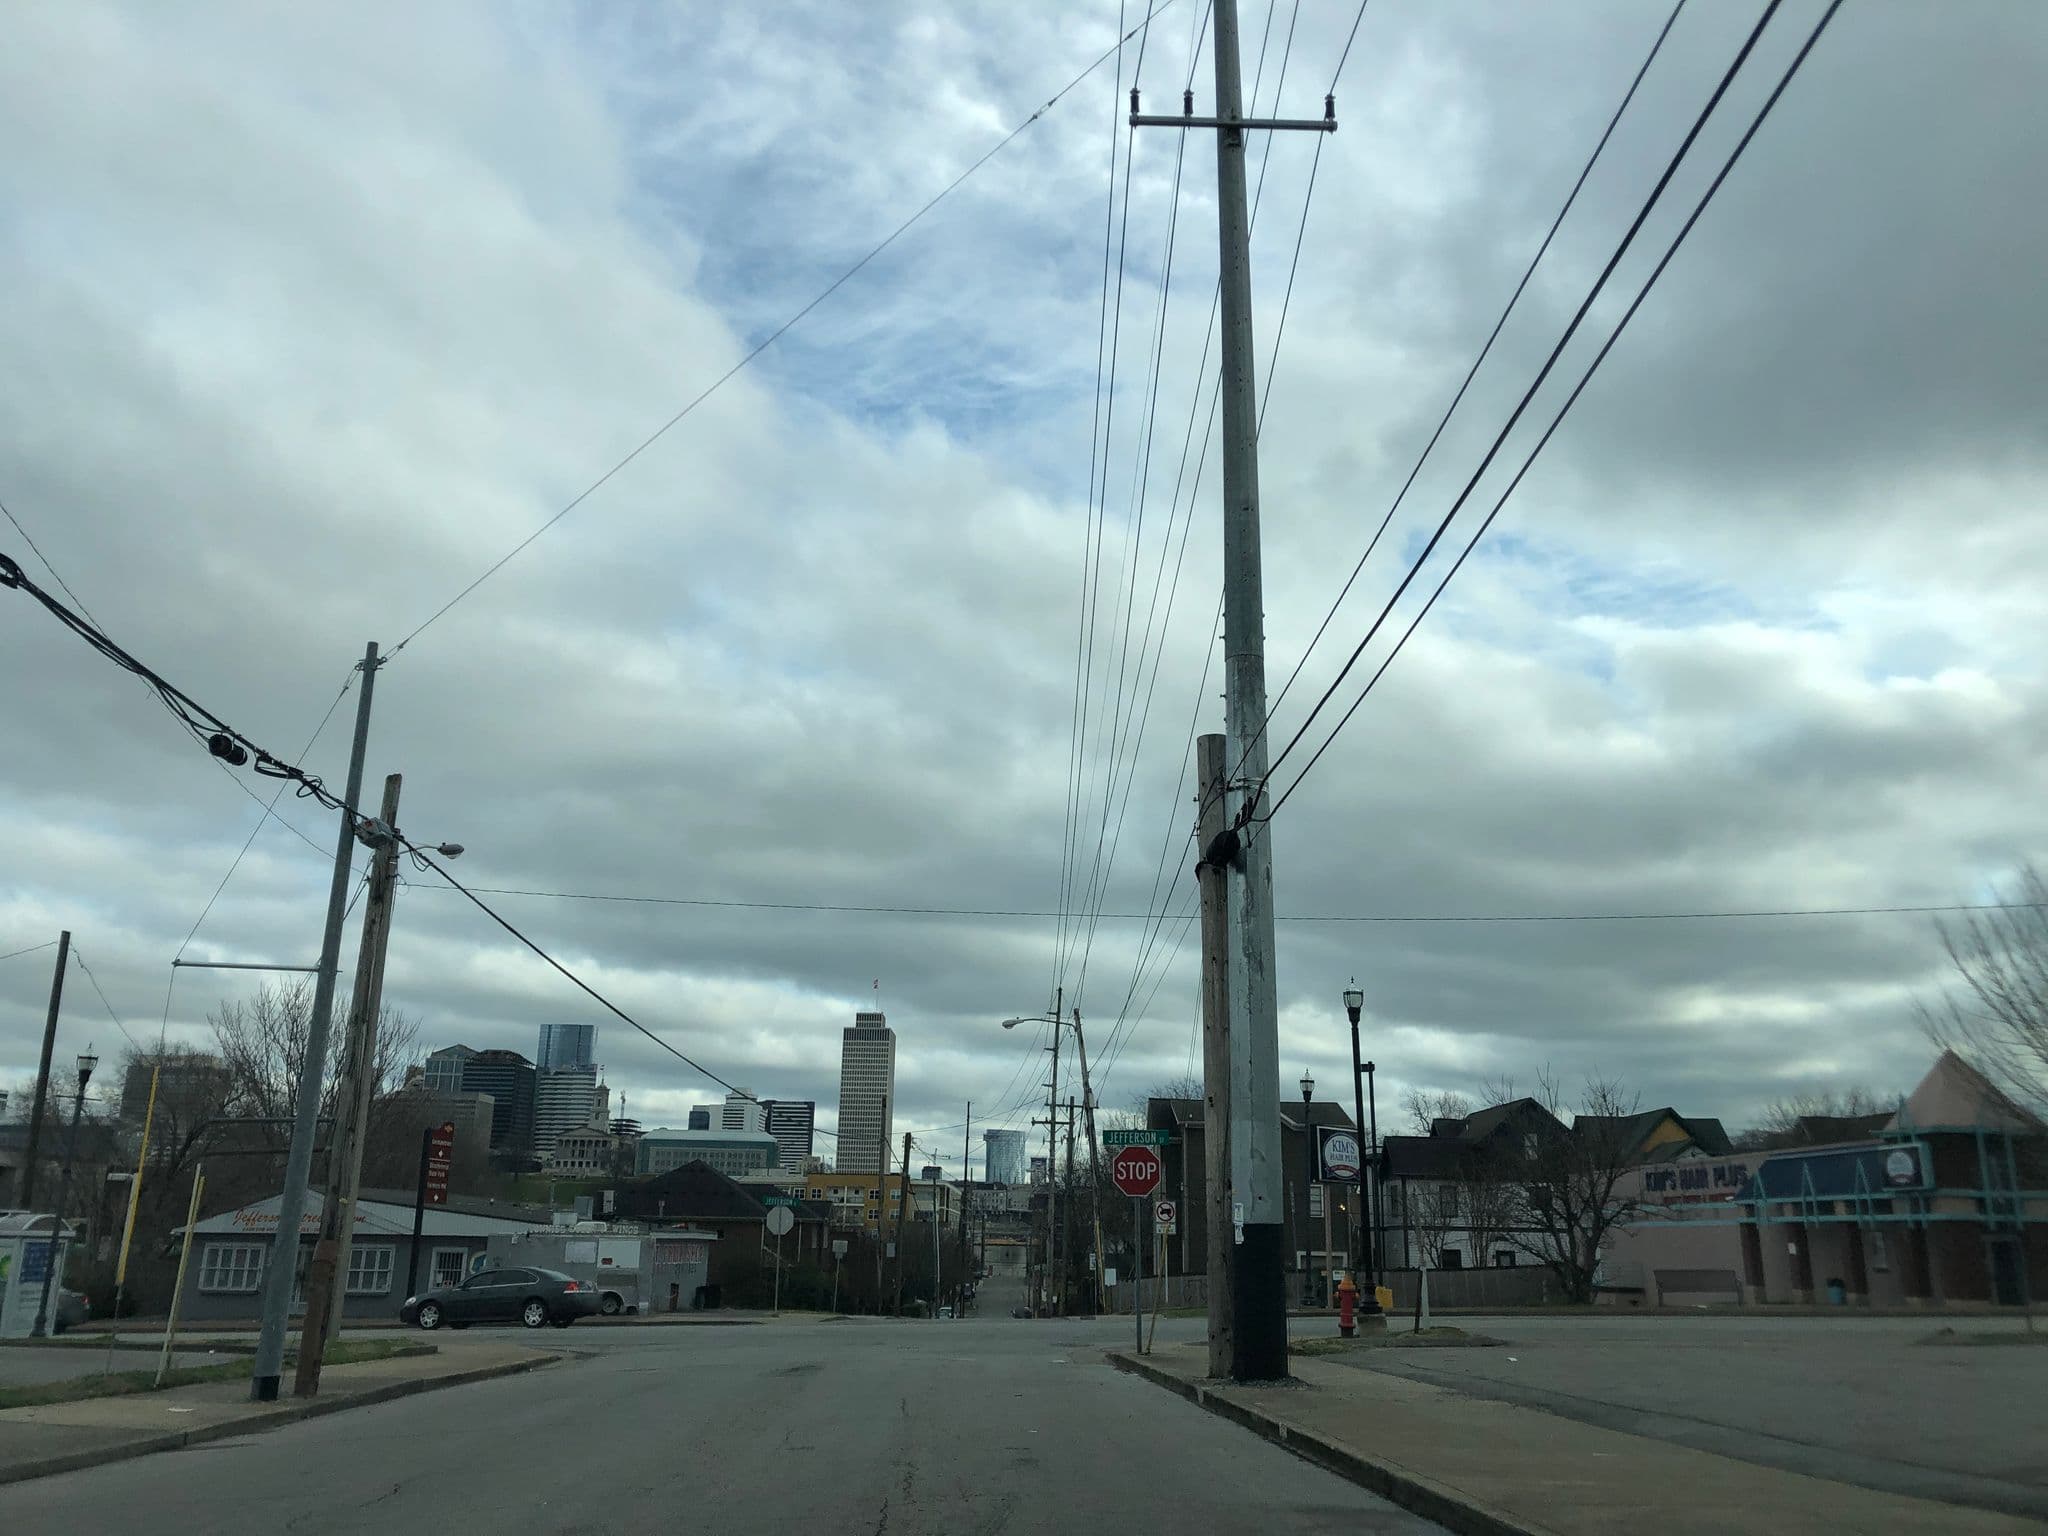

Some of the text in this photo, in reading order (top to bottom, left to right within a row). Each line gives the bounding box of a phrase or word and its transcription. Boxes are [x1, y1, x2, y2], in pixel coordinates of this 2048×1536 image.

[1109, 1132, 1157, 1143] JEFFERSON
[1332, 1139, 1355, 1154] KIM'S
[1117, 1162, 1157, 1180] STOP
[233, 1208, 281, 1226] Jefferso
